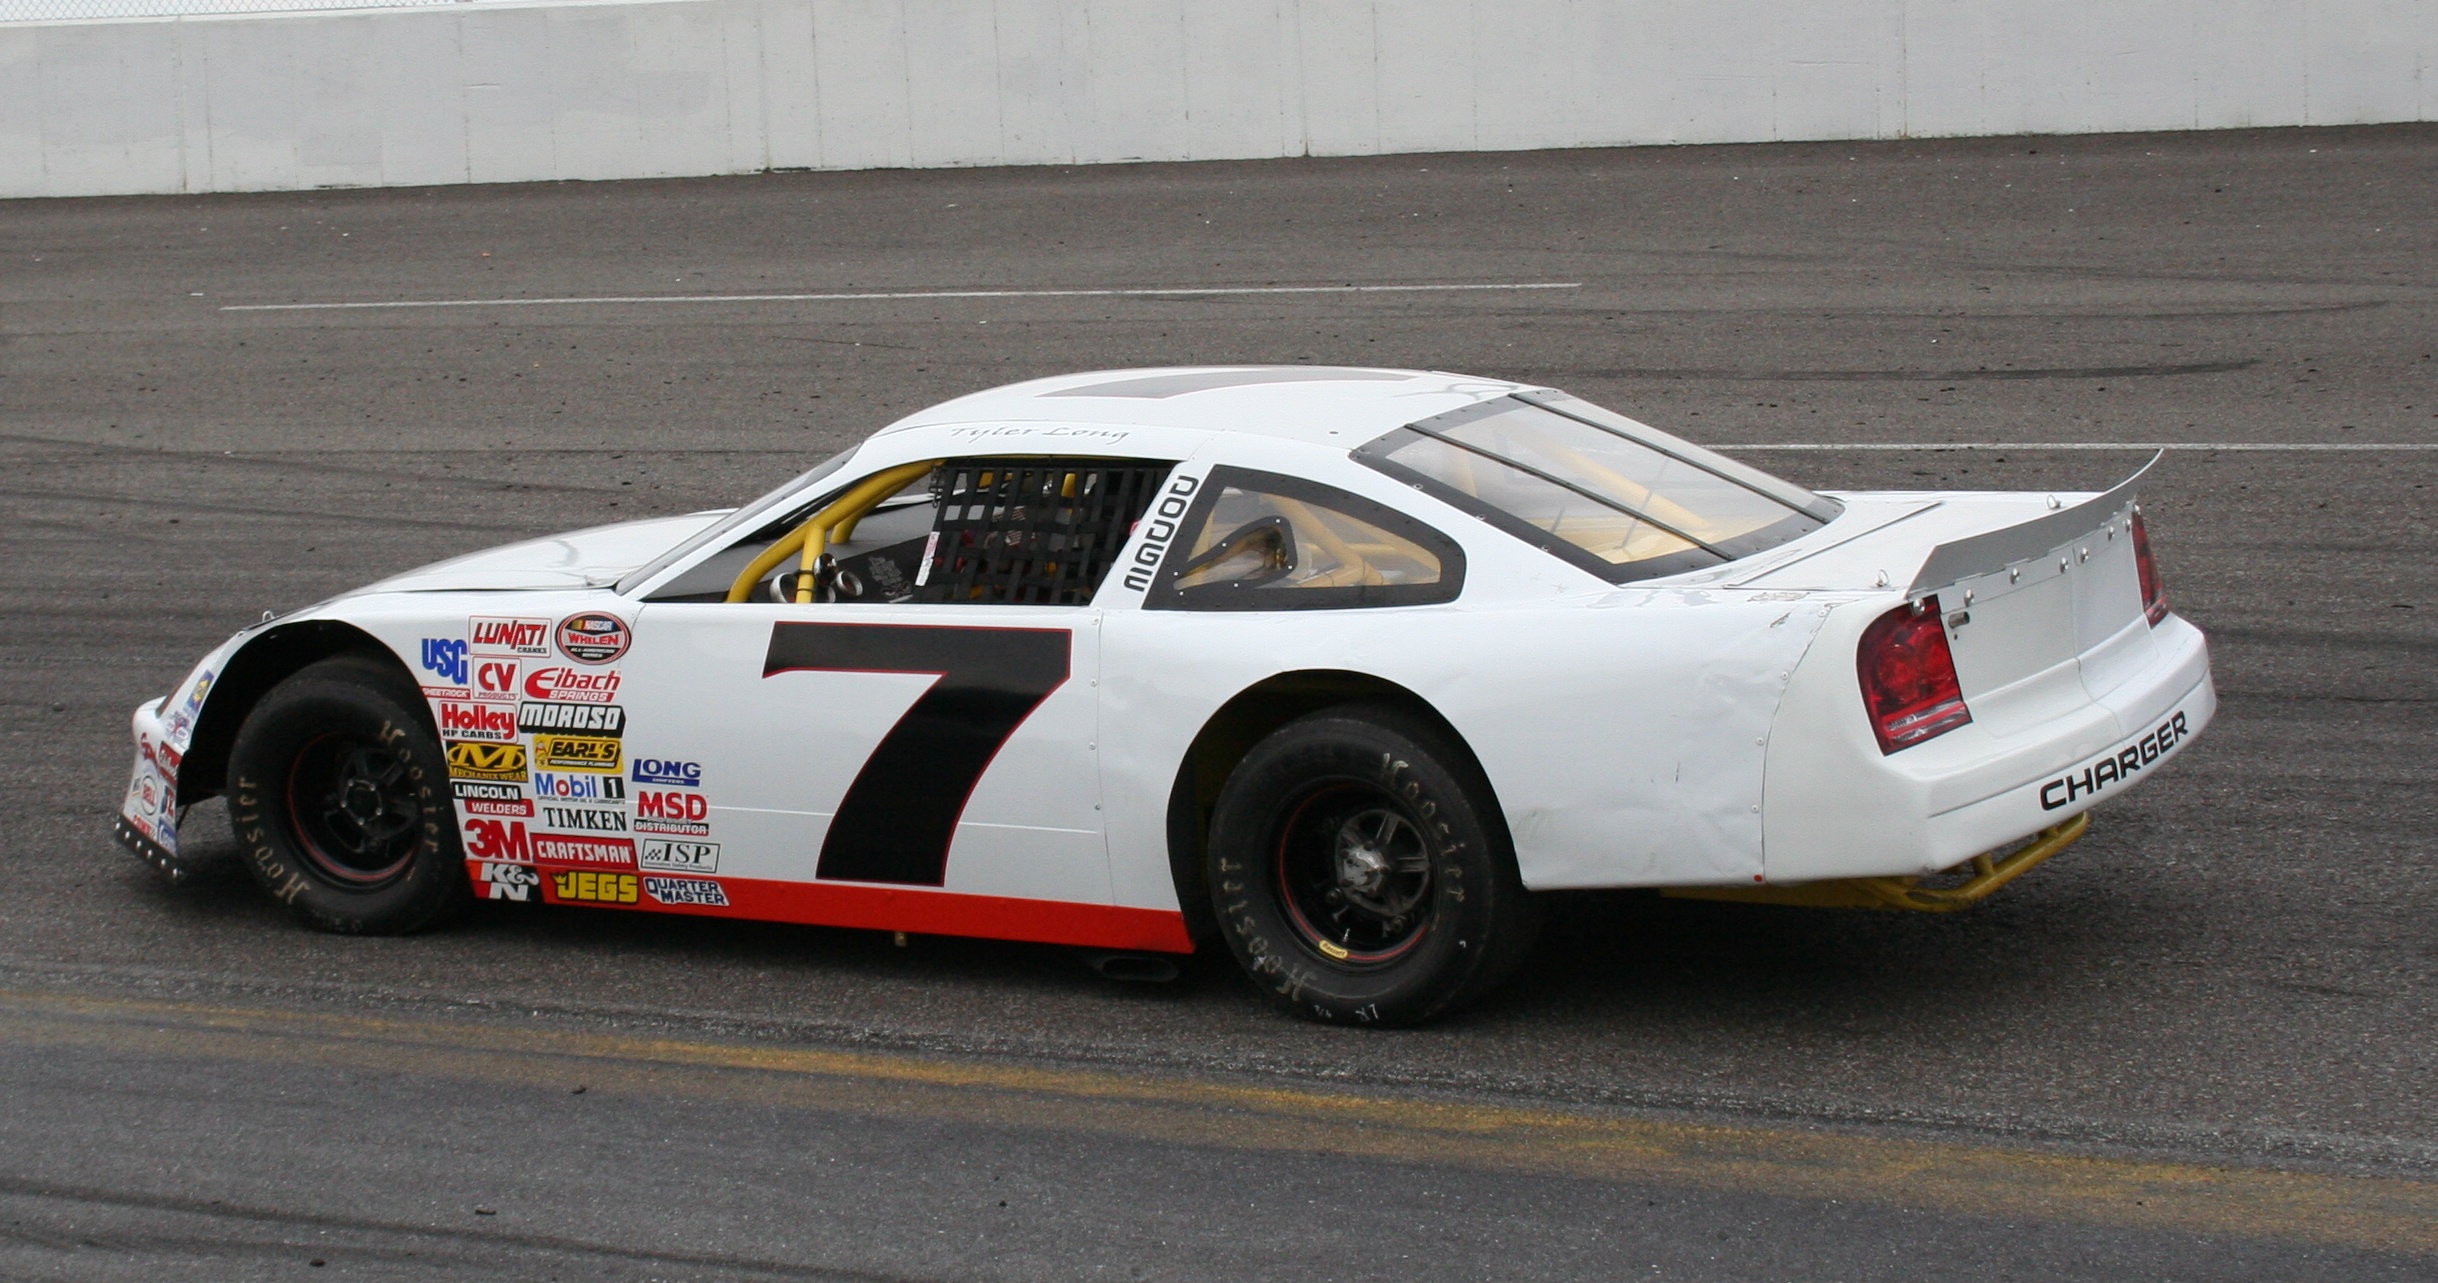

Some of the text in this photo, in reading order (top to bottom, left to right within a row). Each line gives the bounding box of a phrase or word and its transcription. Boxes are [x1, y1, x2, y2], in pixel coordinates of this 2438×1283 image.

[951, 426, 1130, 445] Tyler Long
[1123, 475, 1199, 592] DODGE
[472, 620, 548, 650] LUNATI
[421, 638, 468, 685] USG
[478, 662, 516, 692] CV
[524, 667, 621, 695] Eibach
[548, 690, 609, 701] SPRINGS
[441, 703, 515, 740] Holley
[519, 703, 622, 731] MOROSO
[442, 729, 502, 739] HP CARBS
[550, 741, 615, 759] EARL'S
[762, 620, 1073, 887] 7
[2040, 710, 2188, 811] CHARGER
[449, 766, 527, 782] MECHANIX WEAR
[632, 759, 701, 782] LONG
[454, 784, 519, 801] LINCOLN
[534, 773, 597, 798] Mobil
[471, 802, 527, 815] WELDERS
[638, 791, 707, 821] MSD
[543, 807, 627, 831] TIMKEN
[634, 821, 708, 835] DISTRIBUTOR
[236, 776, 311, 904] Hoosier
[464, 818, 531, 861] 3M
[536, 841, 631, 864] CRAFTSMAN
[663, 843, 711, 864] ISP
[556, 871, 638, 903] JEGS
[645, 878, 719, 894] QUARTER
[660, 890, 726, 905] MASTER
[1221, 859, 1317, 1002] Hoosier
